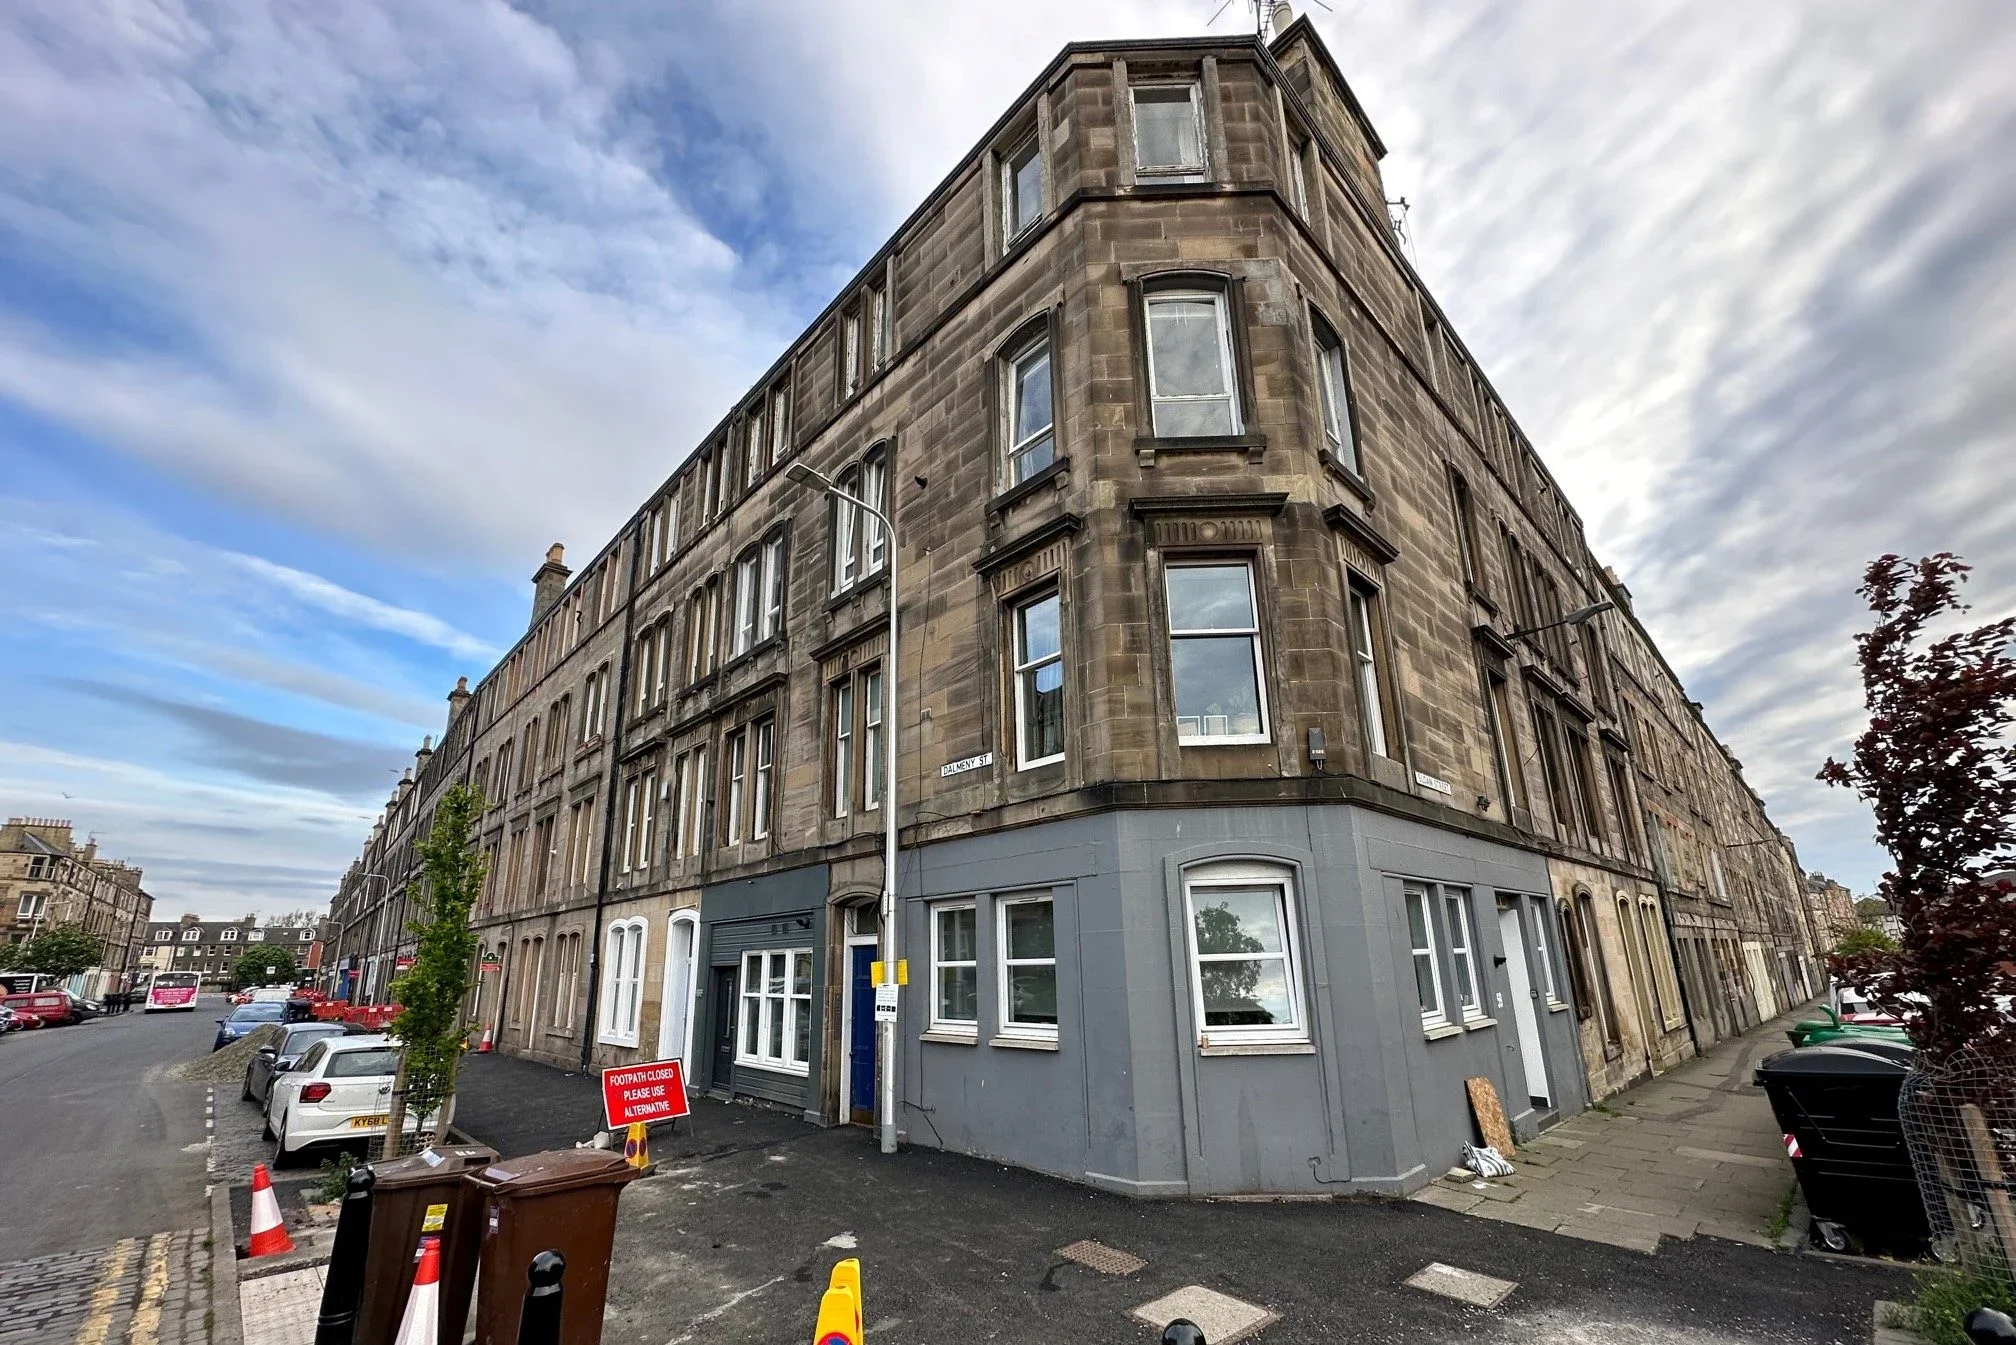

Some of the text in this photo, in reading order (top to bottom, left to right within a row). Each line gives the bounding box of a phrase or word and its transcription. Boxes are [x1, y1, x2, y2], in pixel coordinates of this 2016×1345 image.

[943, 758, 975, 775] DALMENY
[610, 1068, 674, 1086] FOOTPATH CLOSED
[623, 1085, 665, 1101] PLEASE USE
[624, 1101, 670, 1117] ALTERNATIVE
[354, 1117, 380, 1127] KY68
